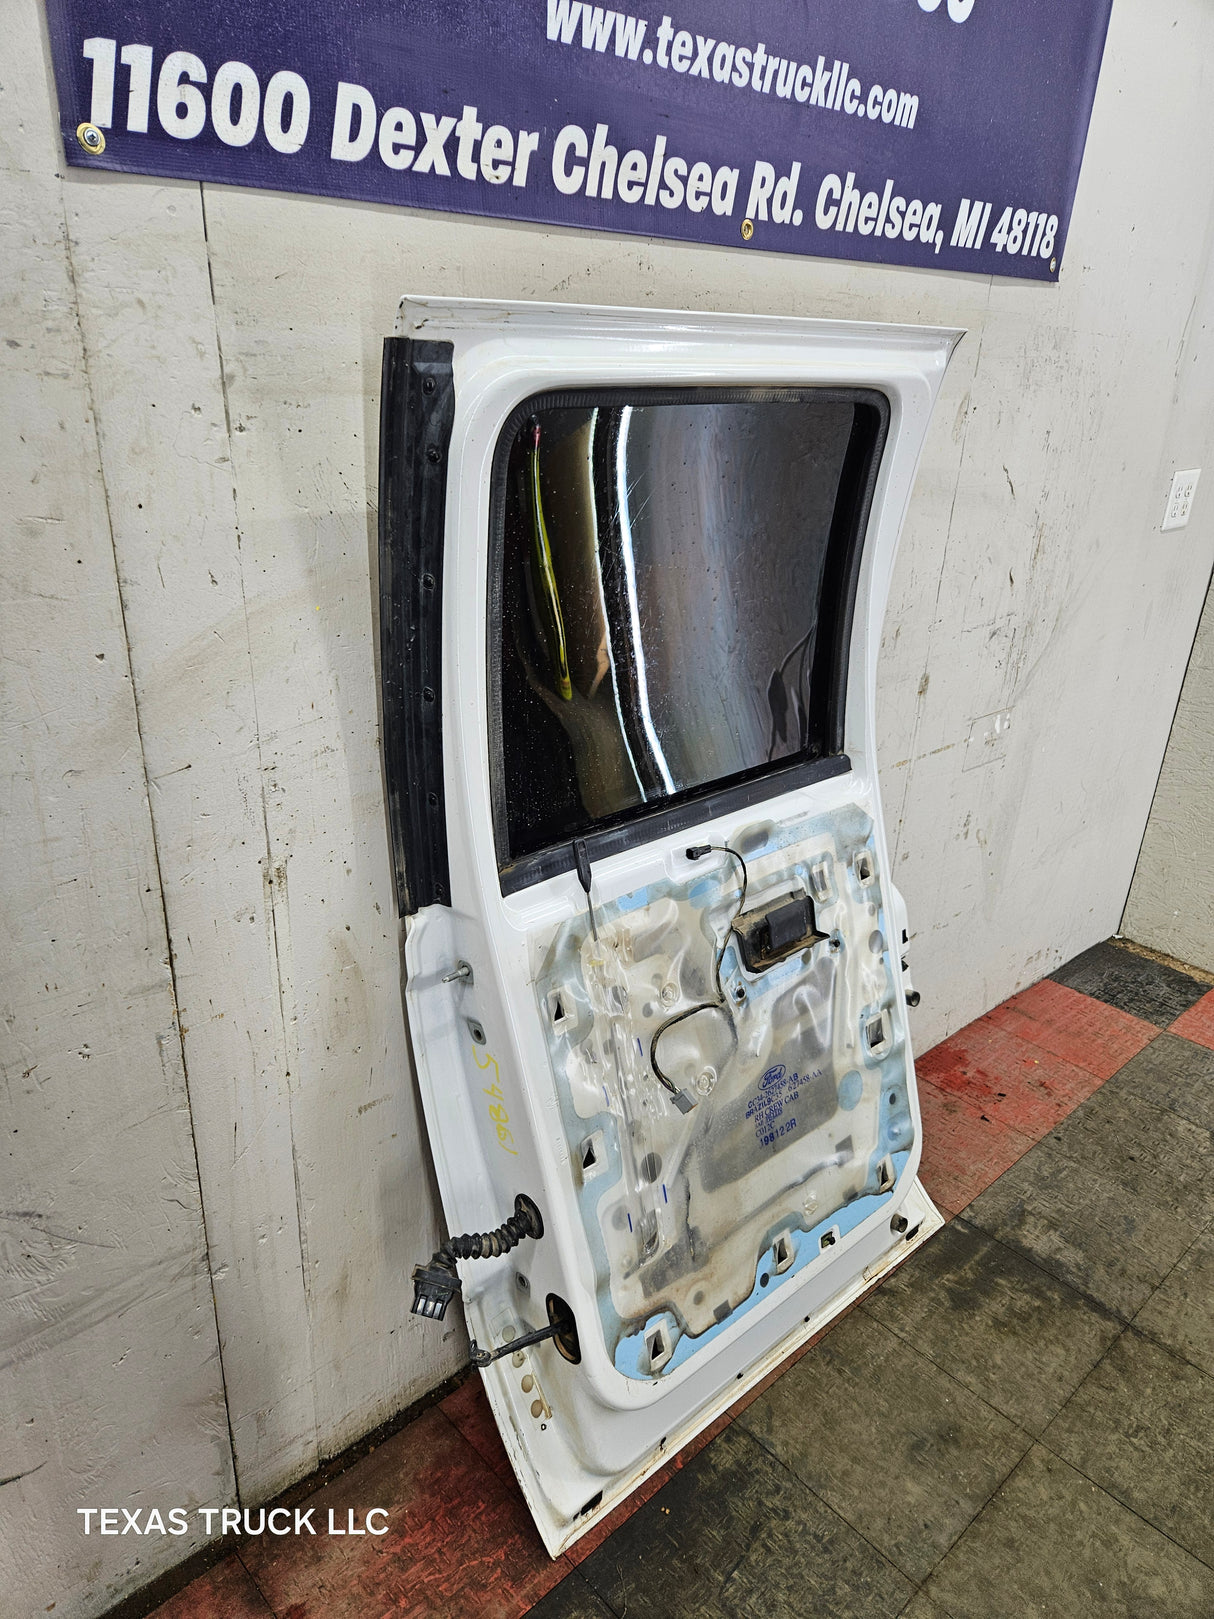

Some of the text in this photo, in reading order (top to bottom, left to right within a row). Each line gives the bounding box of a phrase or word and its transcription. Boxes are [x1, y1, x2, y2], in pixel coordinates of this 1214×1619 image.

[546, 0, 919, 129] www.texastruckllc.com
[83, 37, 1058, 259] 11600 Dexter Chelsea Rd. Chelsea, MI 48118
[761, 1066, 784, 1089] Ford
[765, 1101, 784, 1116] CREW
[784, 1091, 799, 1104] CAB
